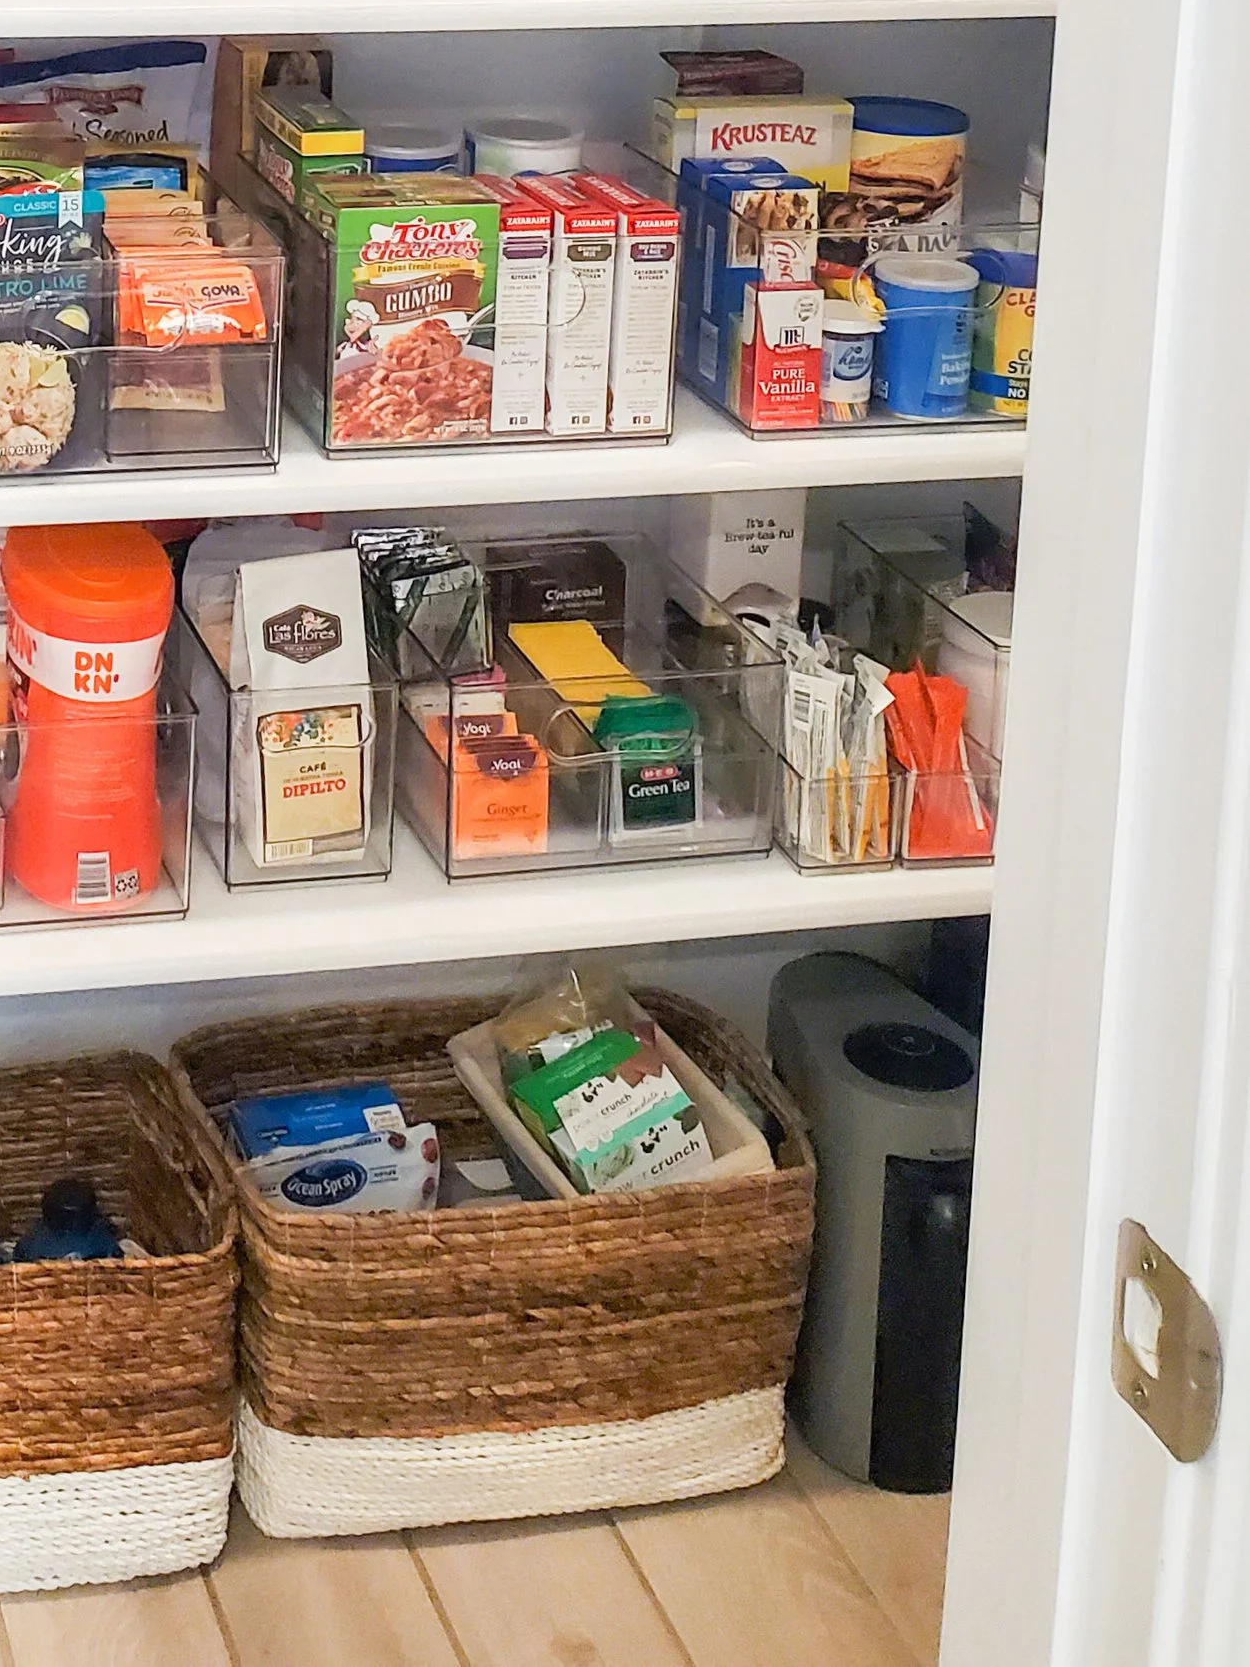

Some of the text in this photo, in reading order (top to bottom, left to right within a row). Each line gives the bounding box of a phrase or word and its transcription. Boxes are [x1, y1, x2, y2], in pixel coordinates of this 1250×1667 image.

[85, 118, 169, 145] Seasoned
[710, 122, 818, 152] KRUSTEAZ
[14, 200, 57, 212] CLASSIC
[62, 199, 79, 212] 15
[507, 217, 551, 226] ZATARAIN'S
[571, 219, 616, 228] ZATARAIN'S
[635, 220, 679, 229] ZATARAIN'S
[41, 273, 88, 292] LIME
[200, 284, 241, 297] GOYA
[385, 282, 452, 313] GUMBO
[772, 368, 806, 380] PURE
[759, 381, 816, 395] Vanilla
[1007, 388, 1026, 398] NO
[746, 518, 776, 530] It's a
[724, 531, 754, 543] Brew
[545, 585, 603, 601] Charcoal
[269, 621, 336, 644] Las flores
[75, 651, 113, 673] DN
[462, 722, 492, 738] Yogi
[299, 761, 327, 774] CAFÉ
[282, 778, 347, 799] DIPILTO
[628, 778, 691, 800] Green Tea
[600, 1093, 633, 1117] crunch
[650, 1137, 701, 1176] crunch
[287, 1170, 358, 1198] Ocean Spray
